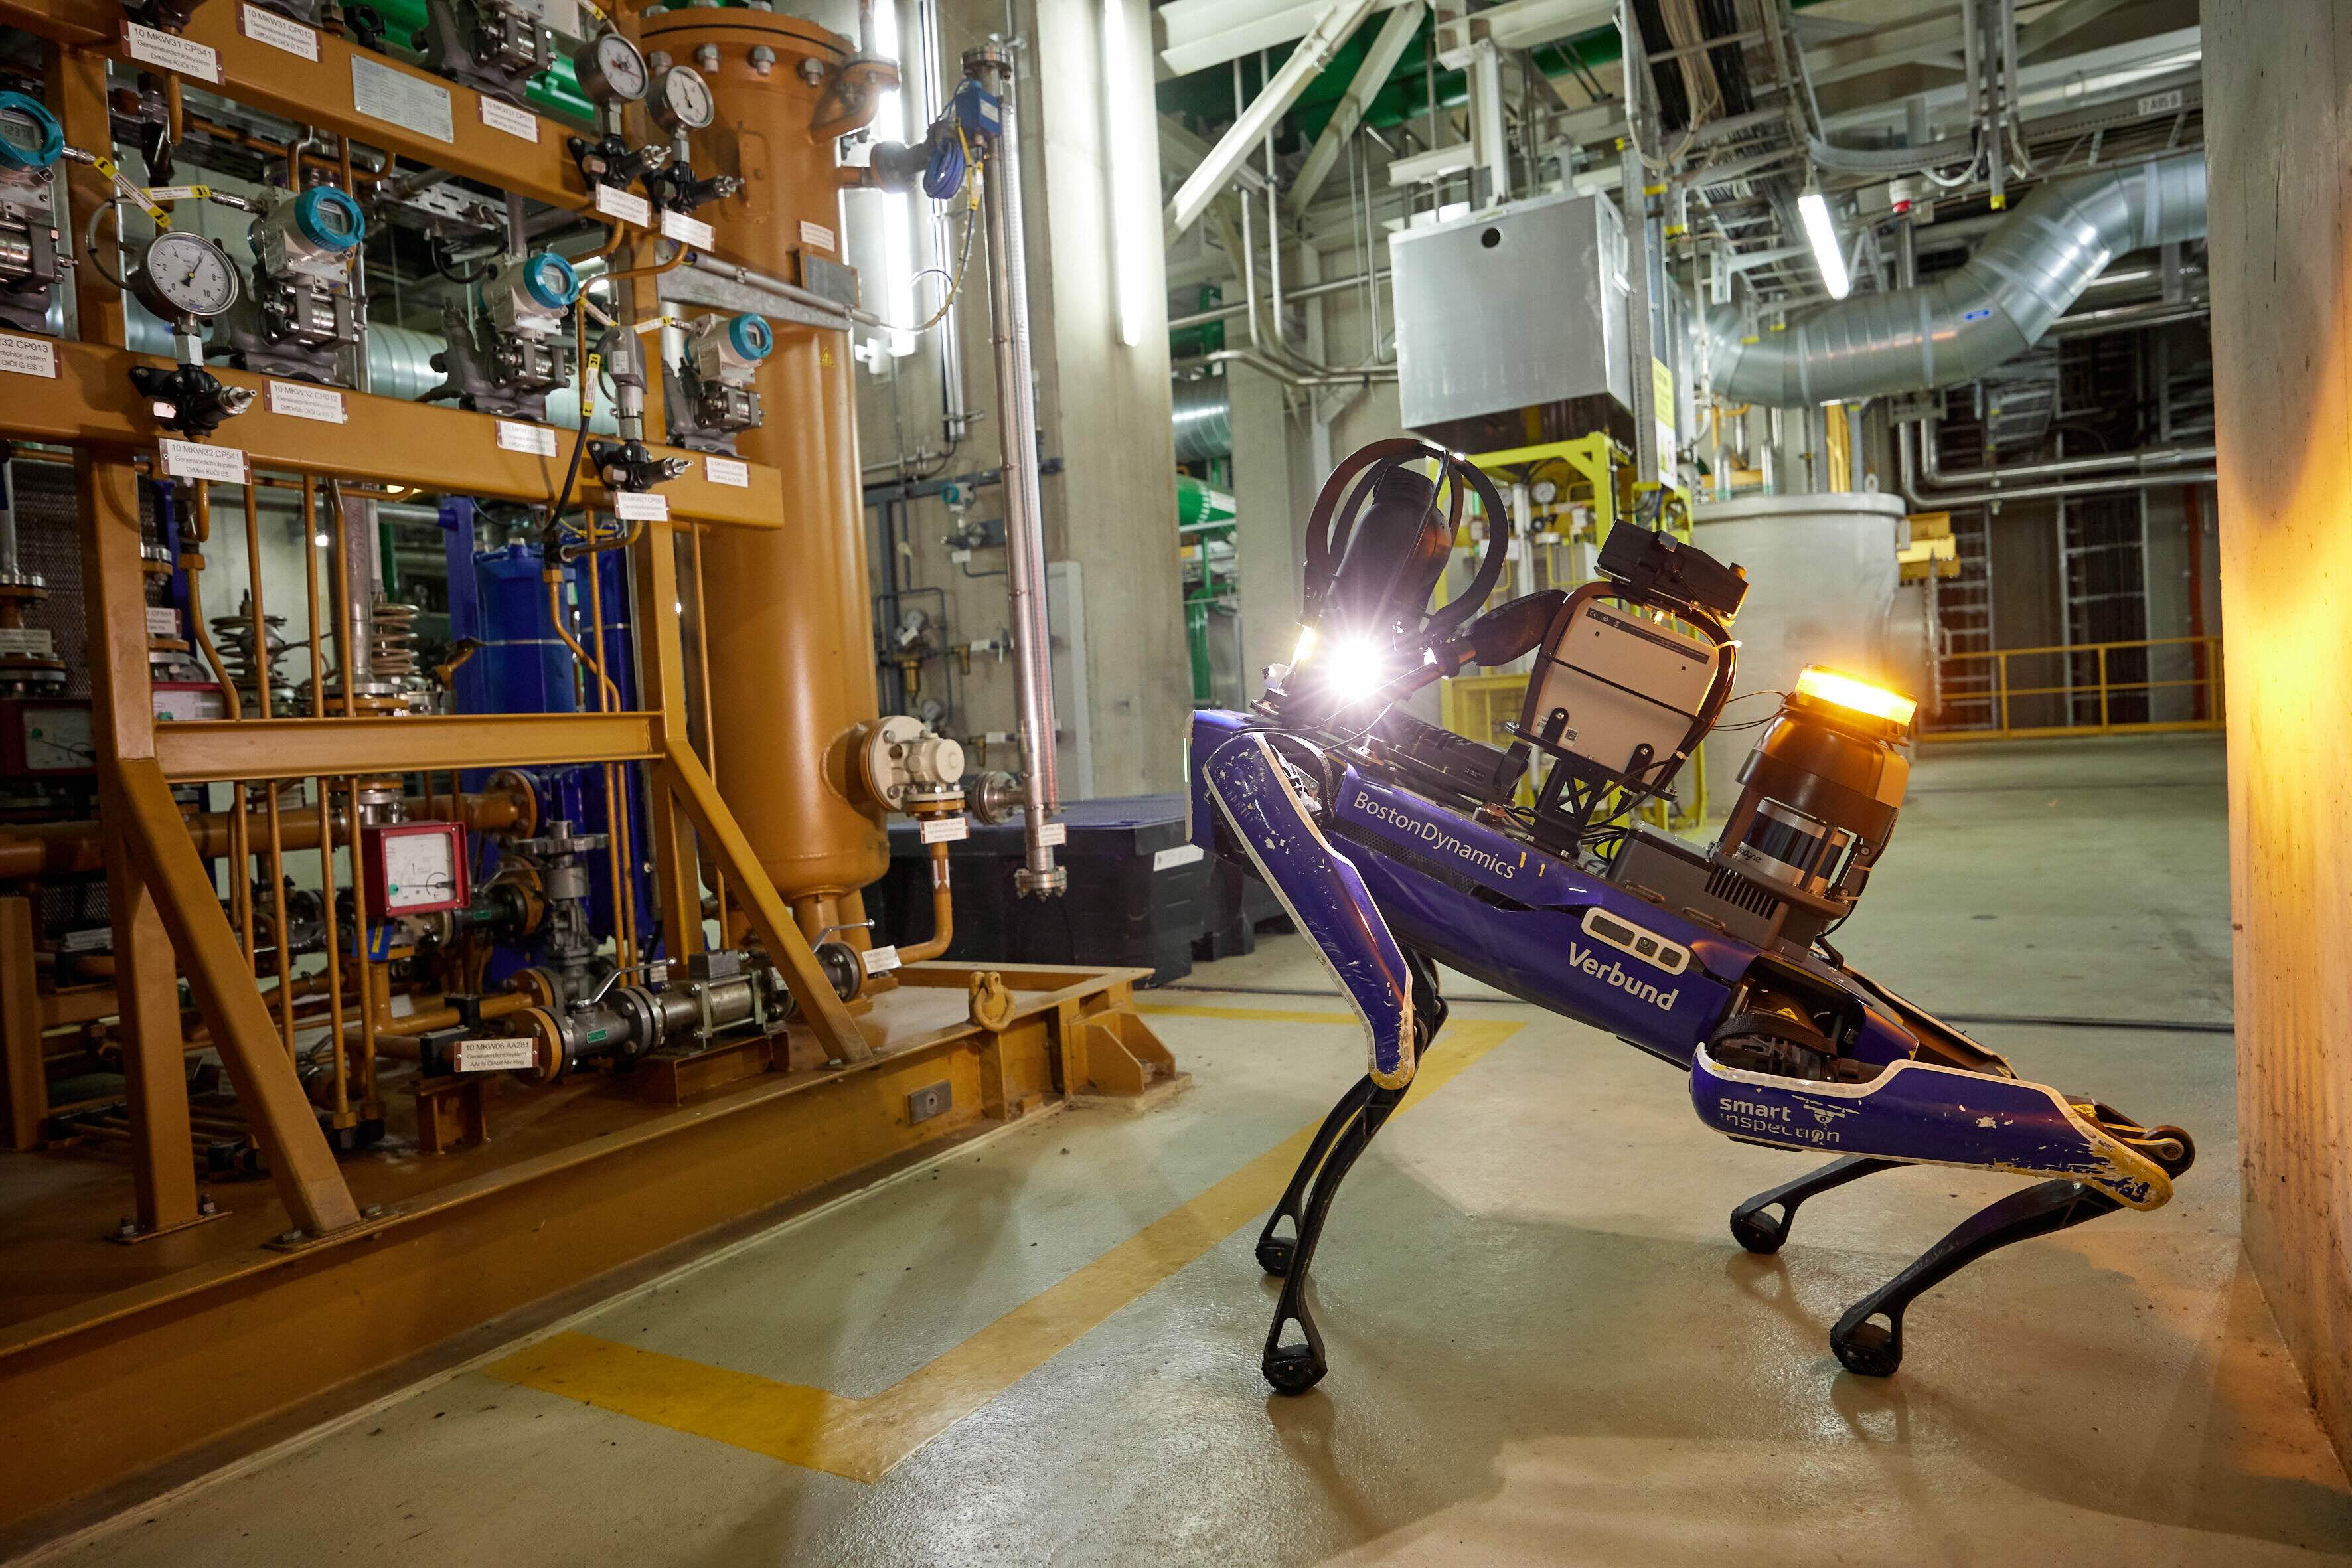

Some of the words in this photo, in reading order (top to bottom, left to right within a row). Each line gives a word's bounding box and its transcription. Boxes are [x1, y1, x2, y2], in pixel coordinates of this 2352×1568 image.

[248, 9, 256, 18] 10
[258, 13, 286, 29] MKW31
[288, 24, 312, 39] CP012
[134, 27, 145, 37] 10
[146, 31, 181, 48] MKW31
[184, 43, 211, 58] CP541
[16, 341, 48, 353] CP013
[284, 386, 313, 397] MKW32
[314, 391, 337, 402] CP012
[183, 445, 212, 457] MKW32
[215, 450, 239, 460] CP541
[1354, 791, 1516, 879] BostonDynamics
[1569, 941, 1680, 1012] Verbund
[1719, 1097, 1792, 1122] smart
